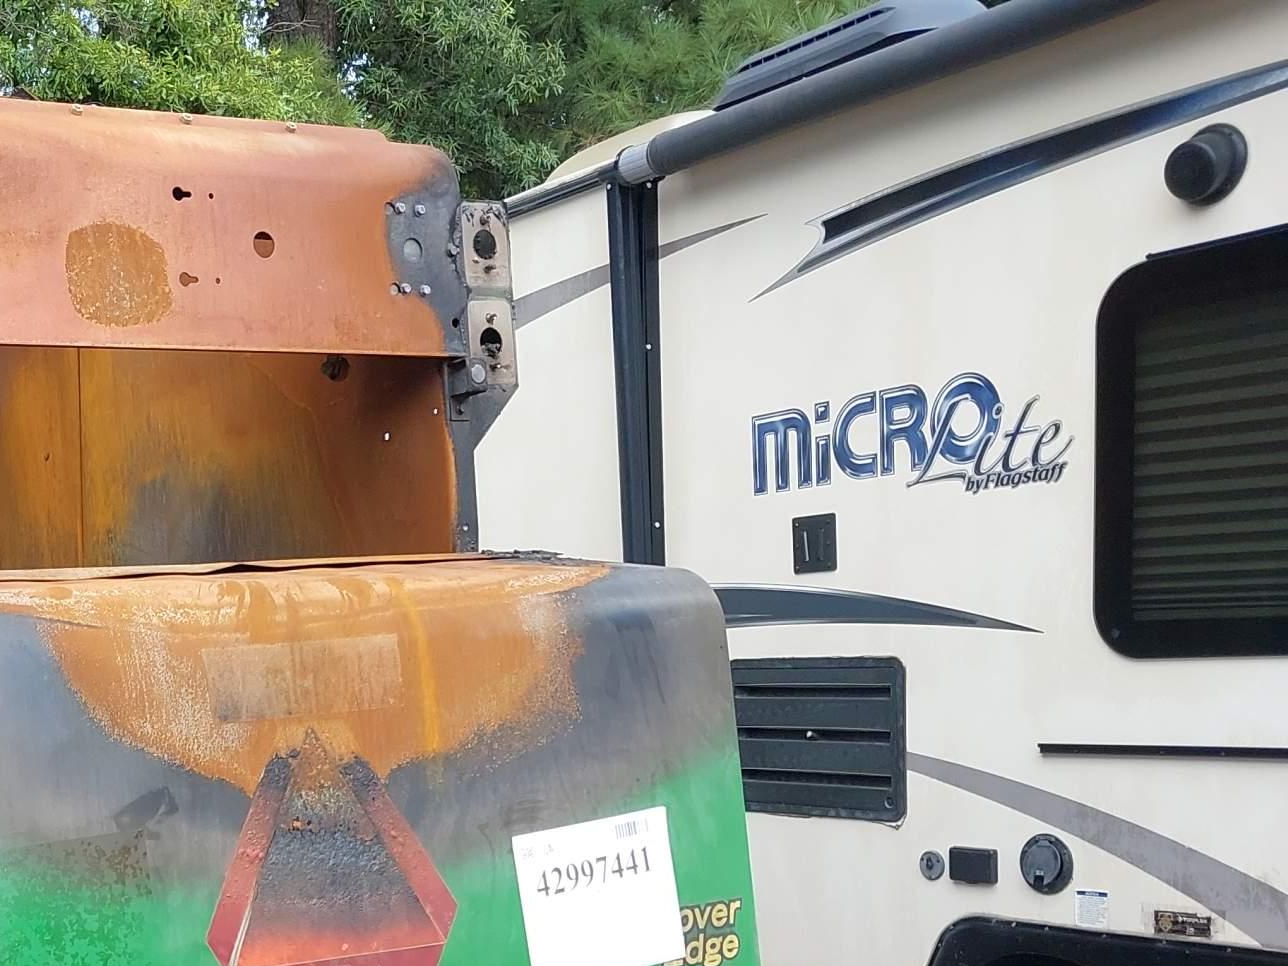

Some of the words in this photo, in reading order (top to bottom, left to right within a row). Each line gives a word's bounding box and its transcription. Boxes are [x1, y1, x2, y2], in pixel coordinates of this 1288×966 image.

[906, 394, 1074, 488] Lite
[966, 475, 983, 495] by
[983, 461, 1068, 491] Flagstaff
[537, 846, 652, 897] 42997441
[679, 897, 742, 934] over
